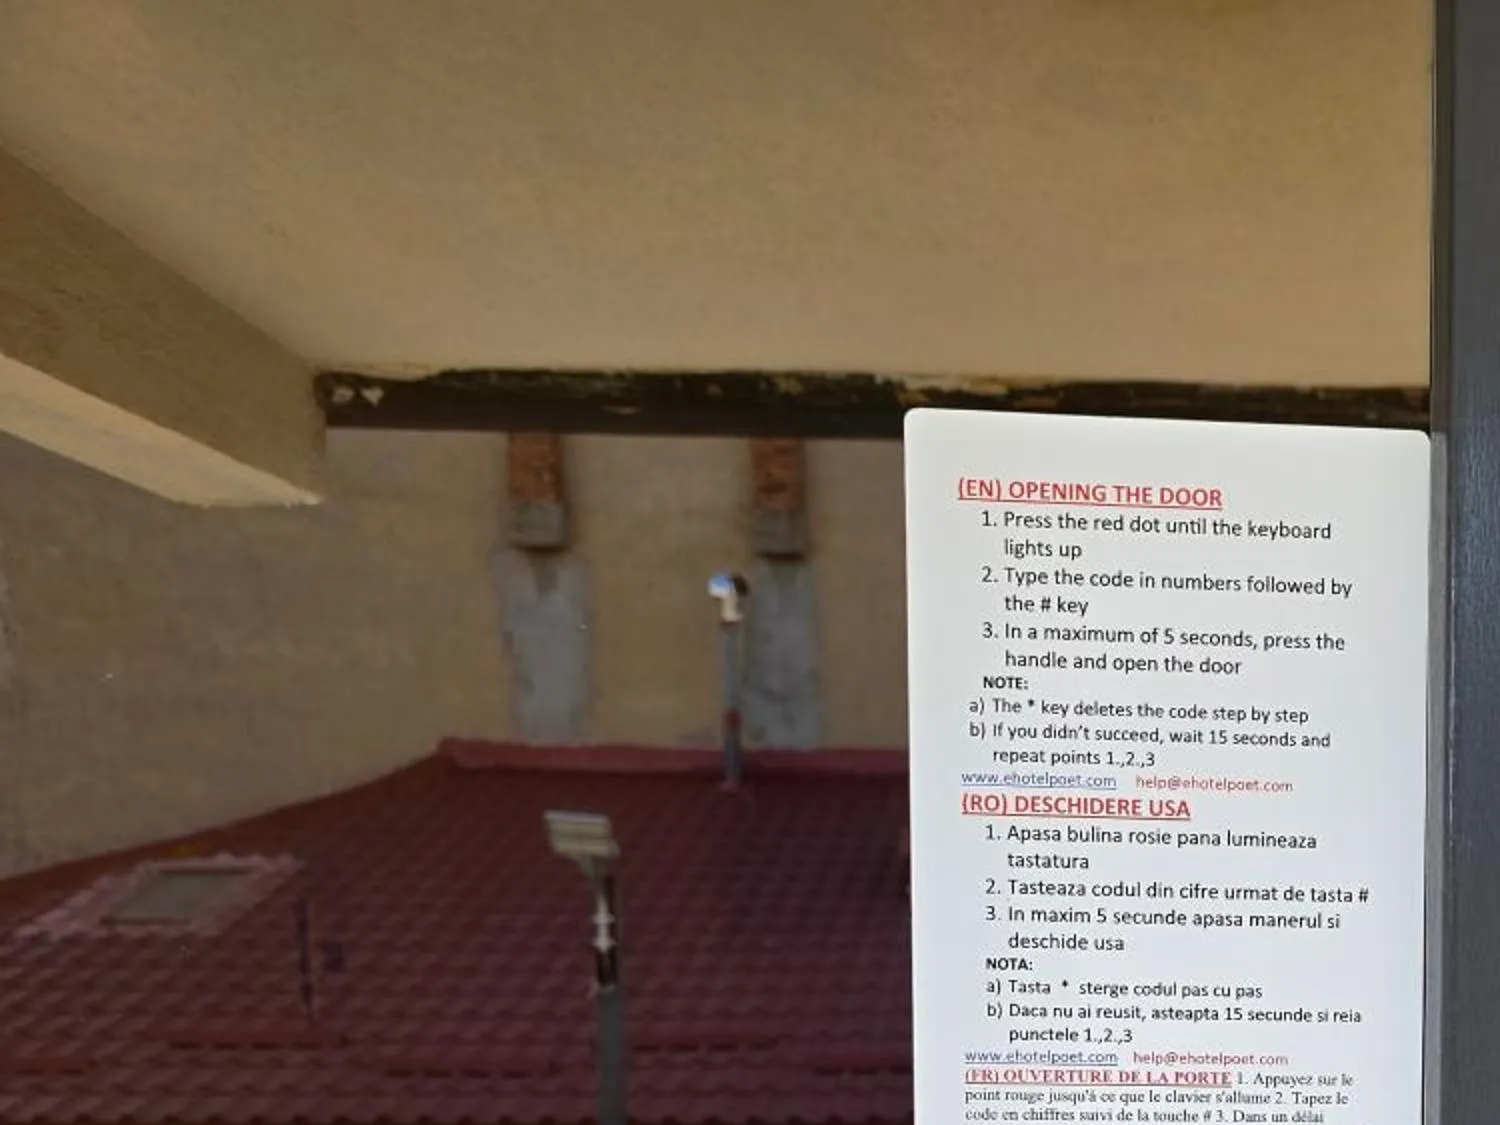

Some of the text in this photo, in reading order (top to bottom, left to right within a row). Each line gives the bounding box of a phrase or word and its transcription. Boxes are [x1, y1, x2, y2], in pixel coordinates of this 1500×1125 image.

[957, 477, 1223, 511] (EN) OPENING THE DOOR
[981, 510, 1332, 543] 1. Press the red dot until the keyboard
[1003, 538, 1083, 561] lights up
[981, 566, 1353, 598] 2. Type the code in numbers followed by
[1004, 594, 1089, 617] the # key
[981, 622, 1346, 652] 3. In a maximum of 5 seconds, press the
[1004, 650, 1243, 675] handle and open the door
[982, 676, 1030, 690] NOTE:
[968, 697, 1310, 725] a) The key deletes the code step by step
[969, 722, 986, 739] b)
[993, 722, 1003, 737] If
[1007, 727, 1038, 740] you
[1095, 727, 1164, 745] succeed,
[1169, 729, 1203, 744] wait
[1210, 730, 1228, 744] 15
[1232, 730, 1297, 746] seconds
[1301, 733, 1331, 747] and
[992, 750, 1047, 766] repeat
[1050, 750, 1102, 768] points
[962, 793, 1190, 822] (RO) DESCHIDERE USA
[985, 824, 1318, 849] 1. Apasa bulina rosie pana lumineaza
[1006, 854, 1090, 869] tastatura
[985, 878, 1369, 903] 2. Tasteaza codul din cifre urmat de tasta #
[984, 905, 1341, 929] 3. In maxim 5 secunde apasa manerul si
[1007, 931, 1125, 951] deschide usa
[985, 957, 1034, 971] NOTA:
[986, 978, 1263, 1000] a) Tasta sterge codul pas cu pas
[986, 1002, 1363, 1023] b) Daca nu ai reusit, asteapta 15 secunde si reia
[1009, 1027, 1079, 1045] punctele
